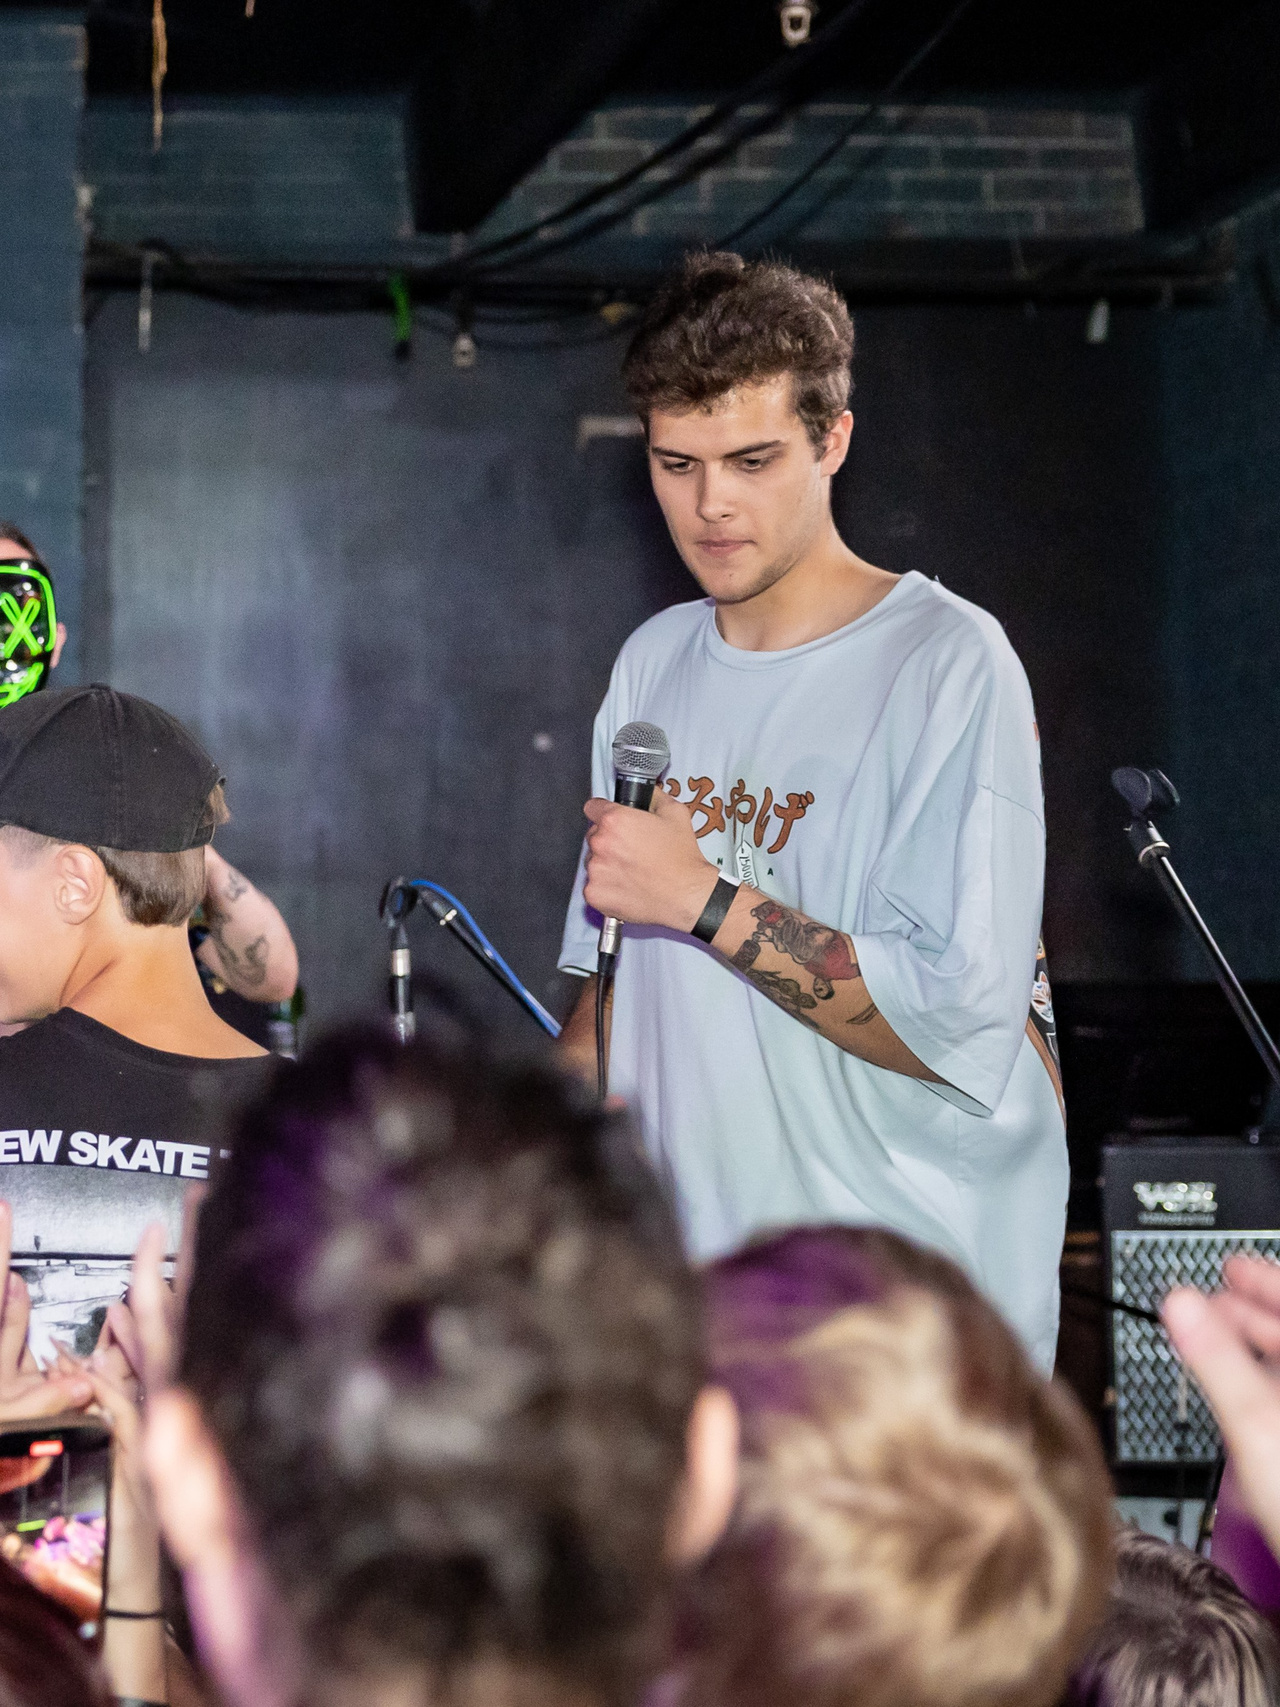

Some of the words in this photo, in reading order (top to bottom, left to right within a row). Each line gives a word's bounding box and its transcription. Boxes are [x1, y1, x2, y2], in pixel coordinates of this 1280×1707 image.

[658, 776, 815, 854] みやげ
[68, 1131, 211, 1179] SKATE
